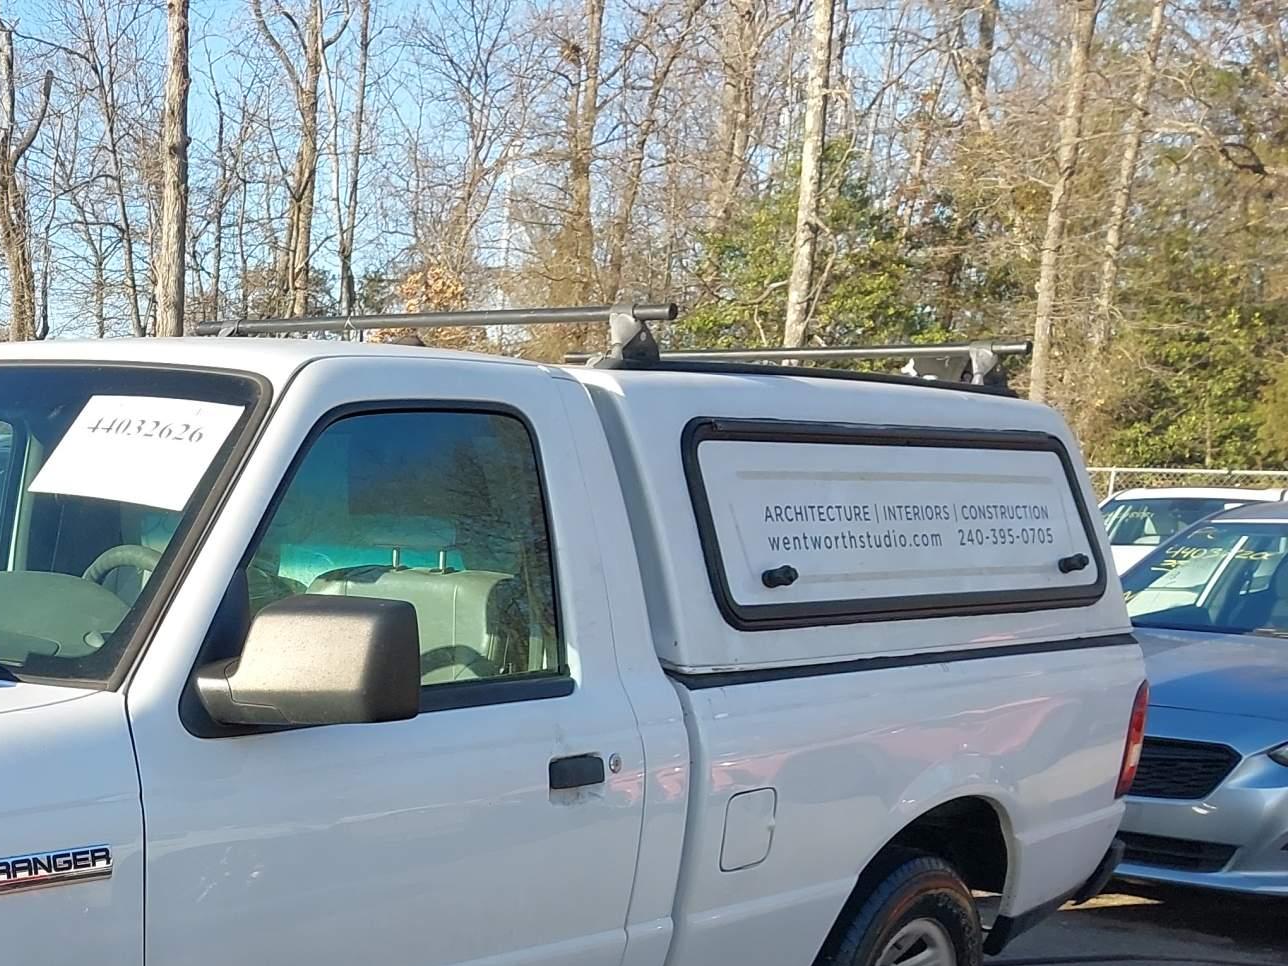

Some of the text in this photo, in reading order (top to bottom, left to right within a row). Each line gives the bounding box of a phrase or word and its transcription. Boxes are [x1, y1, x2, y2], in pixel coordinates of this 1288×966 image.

[87, 416, 204, 443] 44032626
[764, 504, 872, 523] ARCHITECTURE
[883, 504, 951, 521] INTERIORS
[961, 504, 1050, 521] CONSTRUCTION
[767, 527, 1055, 552] wentworthstudio.com 240-395-0705
